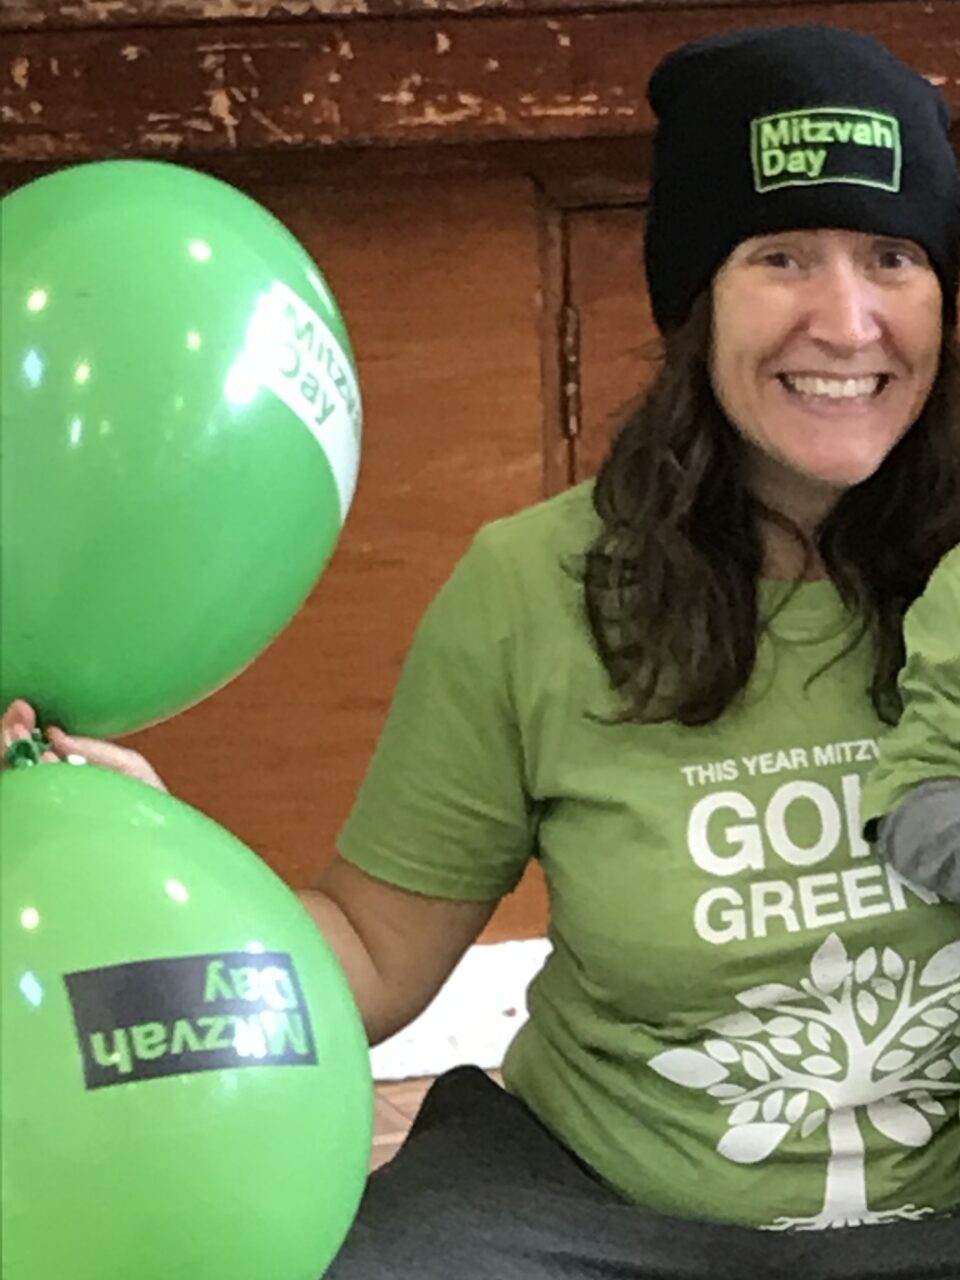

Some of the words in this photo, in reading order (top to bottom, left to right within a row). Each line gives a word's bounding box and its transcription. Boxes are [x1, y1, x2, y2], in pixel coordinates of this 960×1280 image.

[760, 117, 894, 149] Mitzvah
[761, 148, 828, 178] Day
[681, 759, 738, 787] THIS
[742, 747, 809, 776] YEAR
[813, 738, 881, 767] MITZV
[686, 773, 872, 877] GOI
[693, 863, 940, 945] GREEN
[203, 959, 298, 1011] Day
[89, 1010, 309, 1074] Mitzvah
